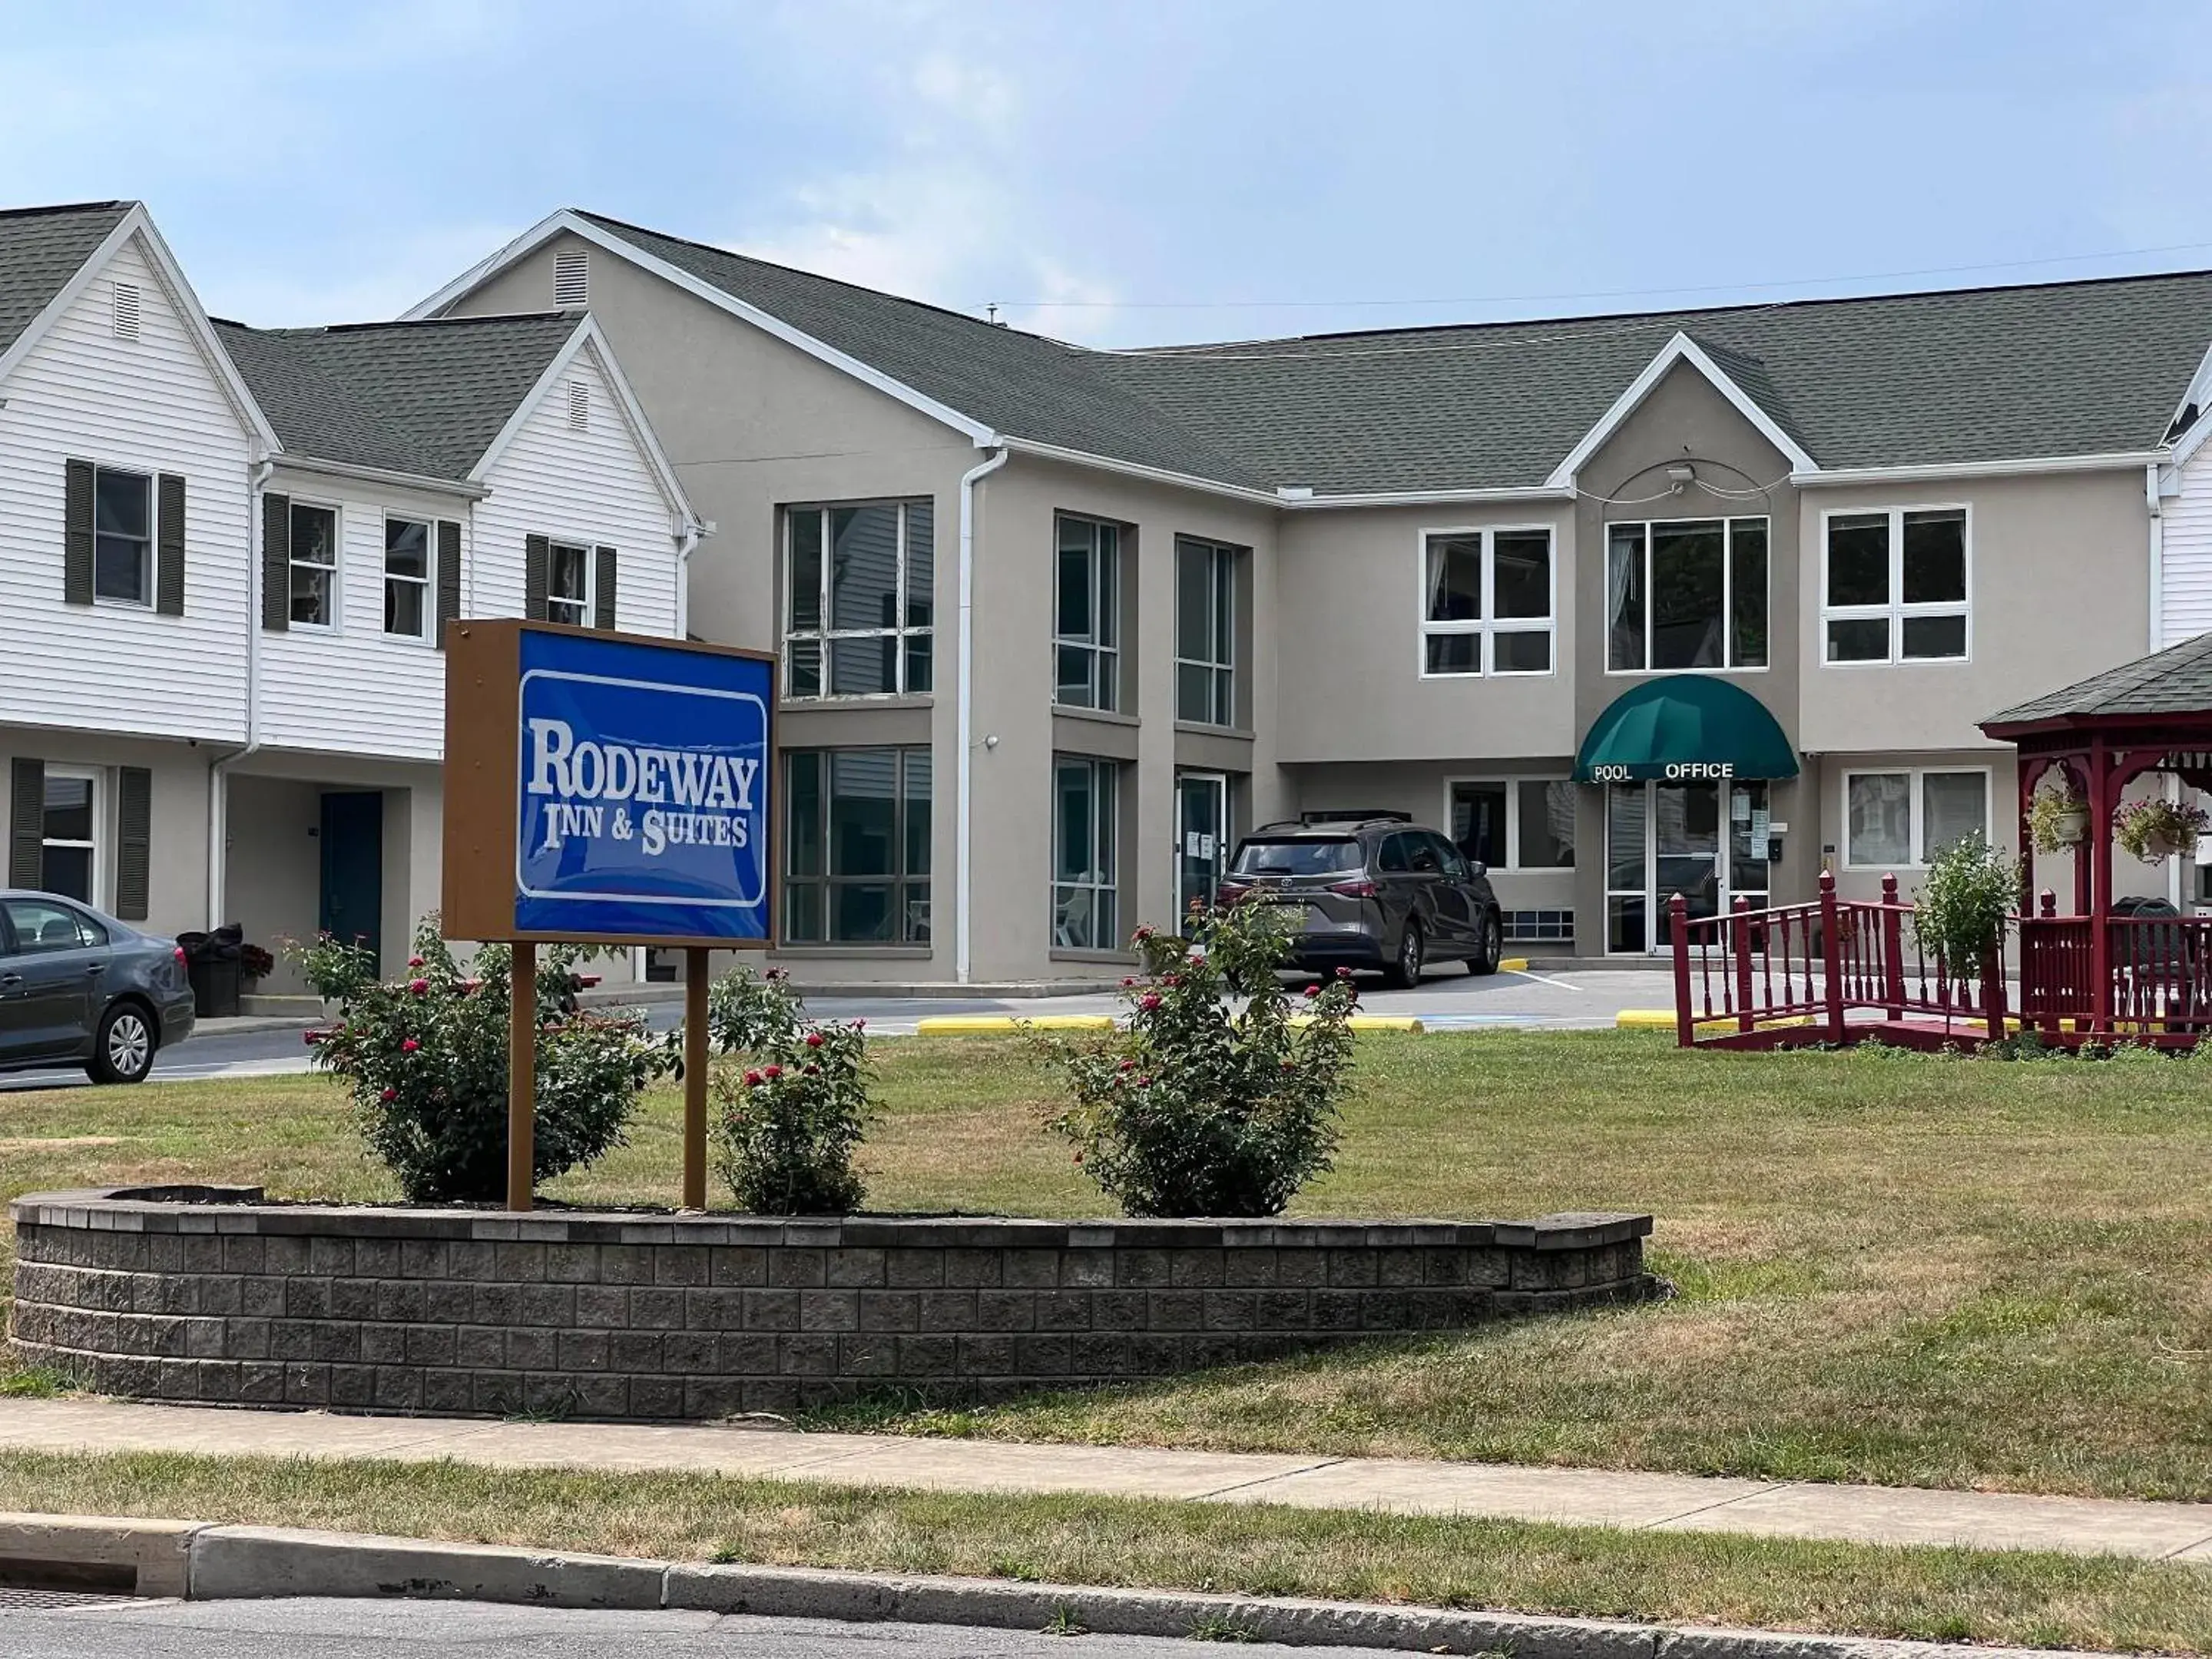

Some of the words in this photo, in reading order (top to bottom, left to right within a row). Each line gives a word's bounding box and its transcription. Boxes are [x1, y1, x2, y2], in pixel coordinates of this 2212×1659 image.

[528, 718, 758, 810] RODEWAY
[1594, 765, 1633, 780] POOL
[1665, 763, 1734, 778] OFFICE
[543, 803, 604, 849] INN
[612, 808, 634, 839] &
[642, 810, 747, 855] SUITES
